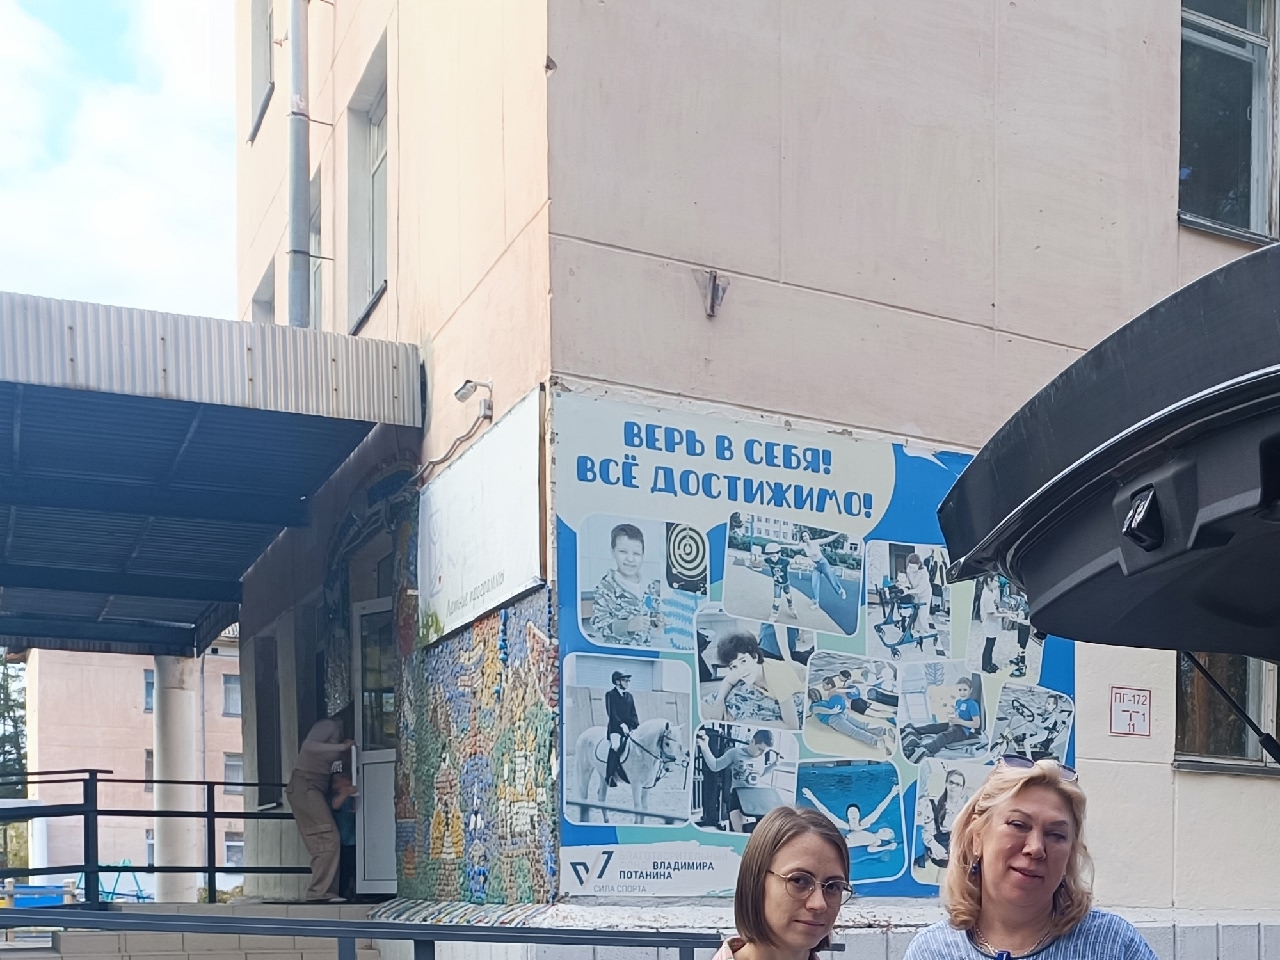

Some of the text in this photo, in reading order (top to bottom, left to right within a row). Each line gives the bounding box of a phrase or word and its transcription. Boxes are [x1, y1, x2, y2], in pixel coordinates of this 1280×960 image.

[623, 421, 832, 475] ВЕРЬ В СЕБЯ!
[576, 454, 873, 519] ВСЁ ДОСТИЖИМО!
[1114, 692, 1148, 706] ПГ-172
[1141, 712, 1146, 722] 1
[1127, 722, 1136, 733] 11
[652, 861, 715, 872] ВЛАДИМИРА
[619, 870, 673, 880] ПОТАНИНА
[593, 884, 647, 893] СИЛА СПОРТА
